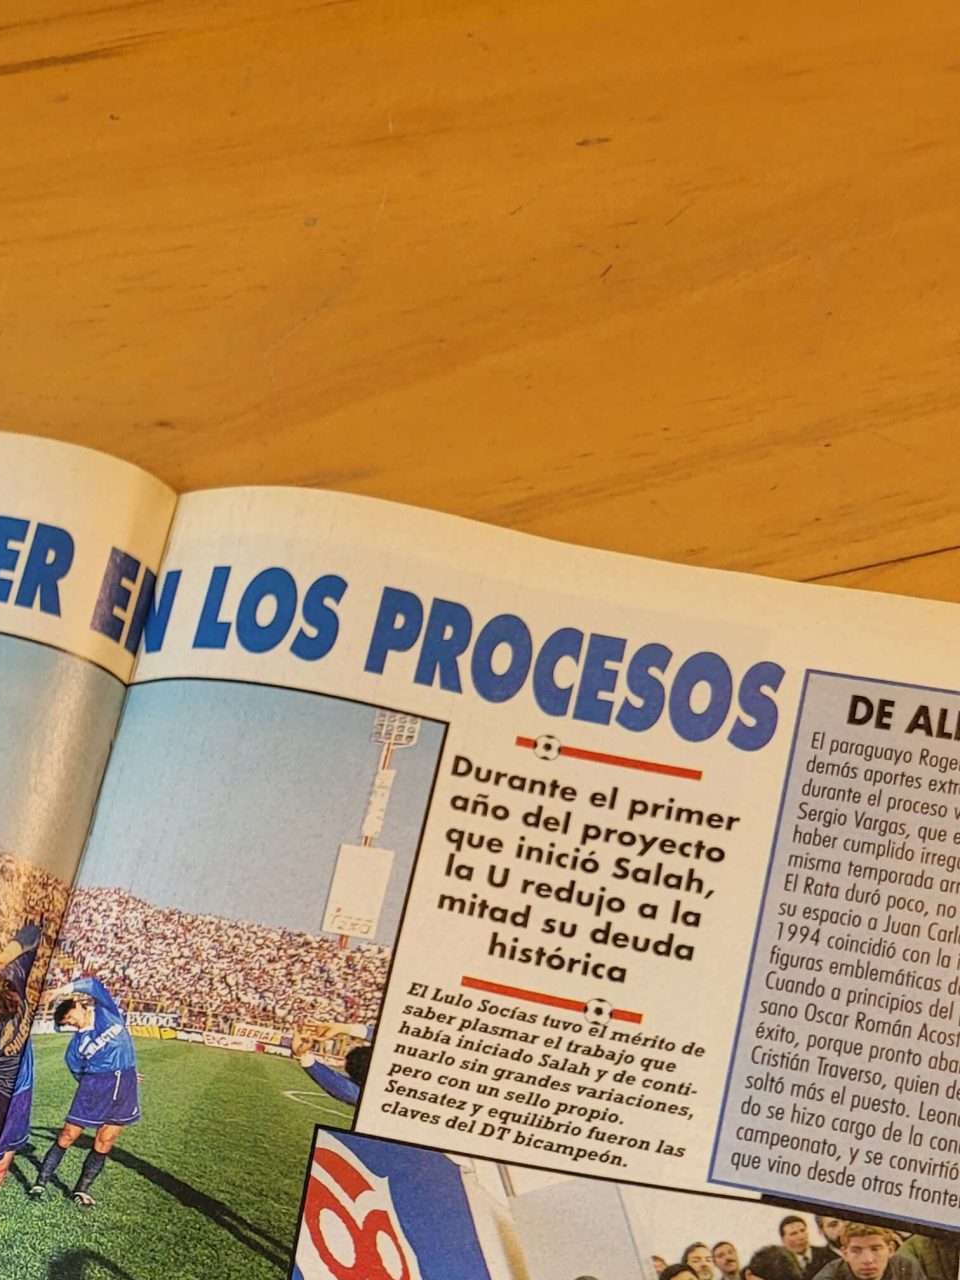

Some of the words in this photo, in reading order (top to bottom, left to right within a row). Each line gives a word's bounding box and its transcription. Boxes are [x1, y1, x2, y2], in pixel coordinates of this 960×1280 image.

[90, 545, 182, 657] EN
[193, 565, 349, 662] LOS
[365, 586, 785, 752] PROCESOS
[810, 730, 827, 751] El
[828, 738, 914, 767] paraguayo
[918, 747, 960, 774] Roge
[846, 693, 896, 731] DE
[904, 704, 960, 742] AL
[450, 754, 578, 803] Durante
[588, 785, 620, 811] el
[626, 797, 741, 832] primer
[800, 777, 863, 805] durante
[866, 788, 884, 808] el
[885, 795, 949, 819] proceso
[805, 753, 860, 780] demás
[862, 767, 923, 790] aportes
[927, 778, 960, 796] extr
[449, 792, 511, 822] año
[521, 804, 573, 836] del
[579, 823, 726, 864] proyecto
[796, 801, 848, 829] Sergio
[854, 809, 911, 841] Vargas,
[917, 825, 949, 844] que
[444, 852, 475, 882] la
[486, 863, 511, 889] U
[520, 878, 626, 918] redujo
[637, 902, 659, 921] a
[670, 899, 702, 929] la
[445, 827, 504, 855] que
[515, 835, 600, 875] inició
[611, 856, 715, 900] Salah,
[436, 892, 533, 929] mitad
[540, 917, 578, 939] su
[589, 920, 695, 962] deuda
[487, 931, 628, 984] histórica
[401, 1004, 458, 1026] saber
[456, 1017, 541, 1045] plasmar
[542, 1035, 564, 1051] el
[565, 1039, 636, 1067] trabajo
[639, 1056, 677, 1073] que
[406, 981, 430, 999] El
[429, 987, 474, 1010] Lulo
[476, 998, 539, 1025] Socías
[541, 1014, 584, 1034] tuvo
[608, 1030, 677, 1053] mérito
[680, 1041, 706, 1058] de
[397, 1020, 452, 1046] había
[454, 1034, 534, 1065] iniciado
[536, 1053, 591, 1078] Salah
[593, 1068, 610, 1084] y
[612, 1069, 637, 1086] de
[641, 1077, 698, 1097] conti-
